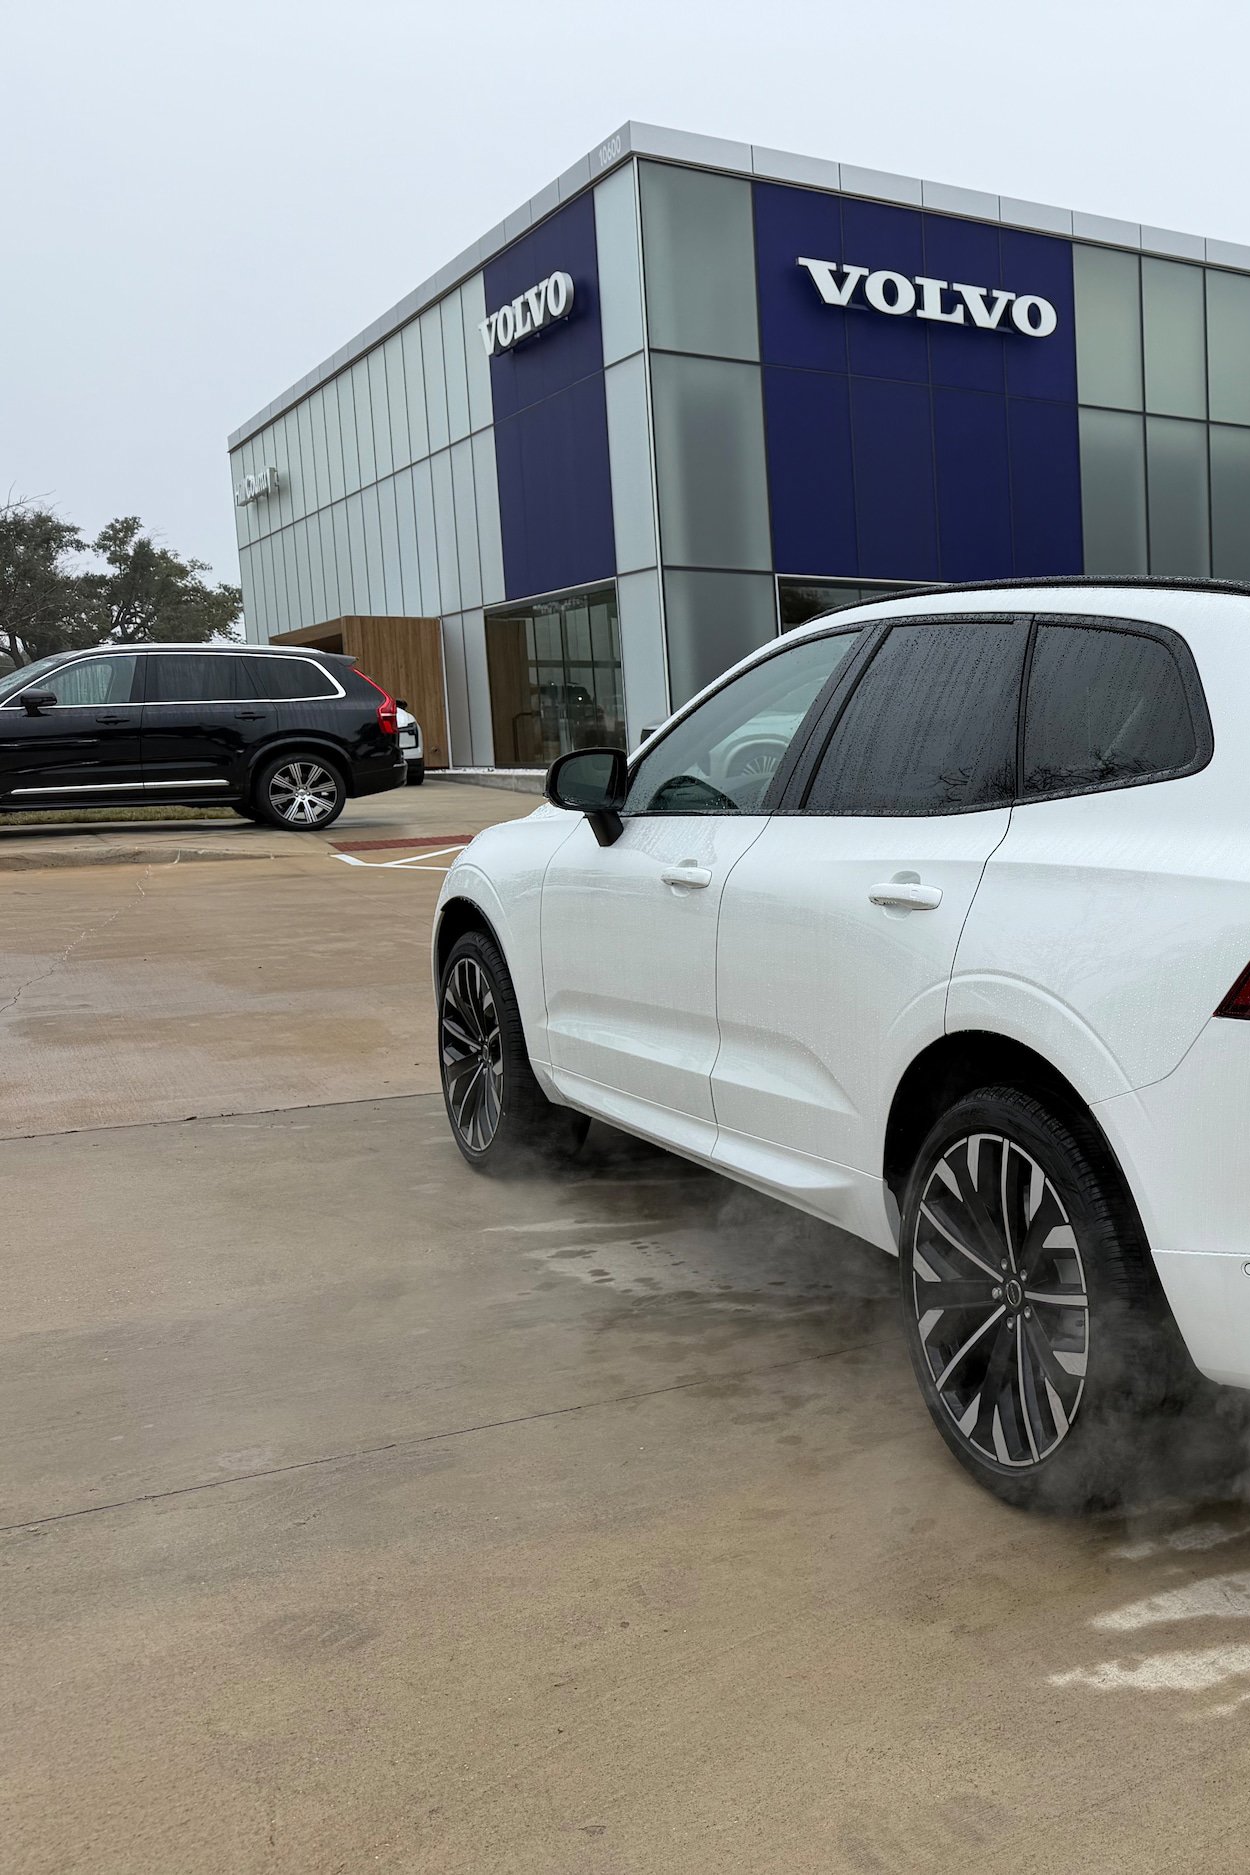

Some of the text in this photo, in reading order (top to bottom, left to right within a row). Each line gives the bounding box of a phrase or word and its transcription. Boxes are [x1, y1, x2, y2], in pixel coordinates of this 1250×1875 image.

[599, 135, 621, 167] 10600
[479, 271, 574, 357] VOLVO
[796, 256, 1058, 338] VOLVO
